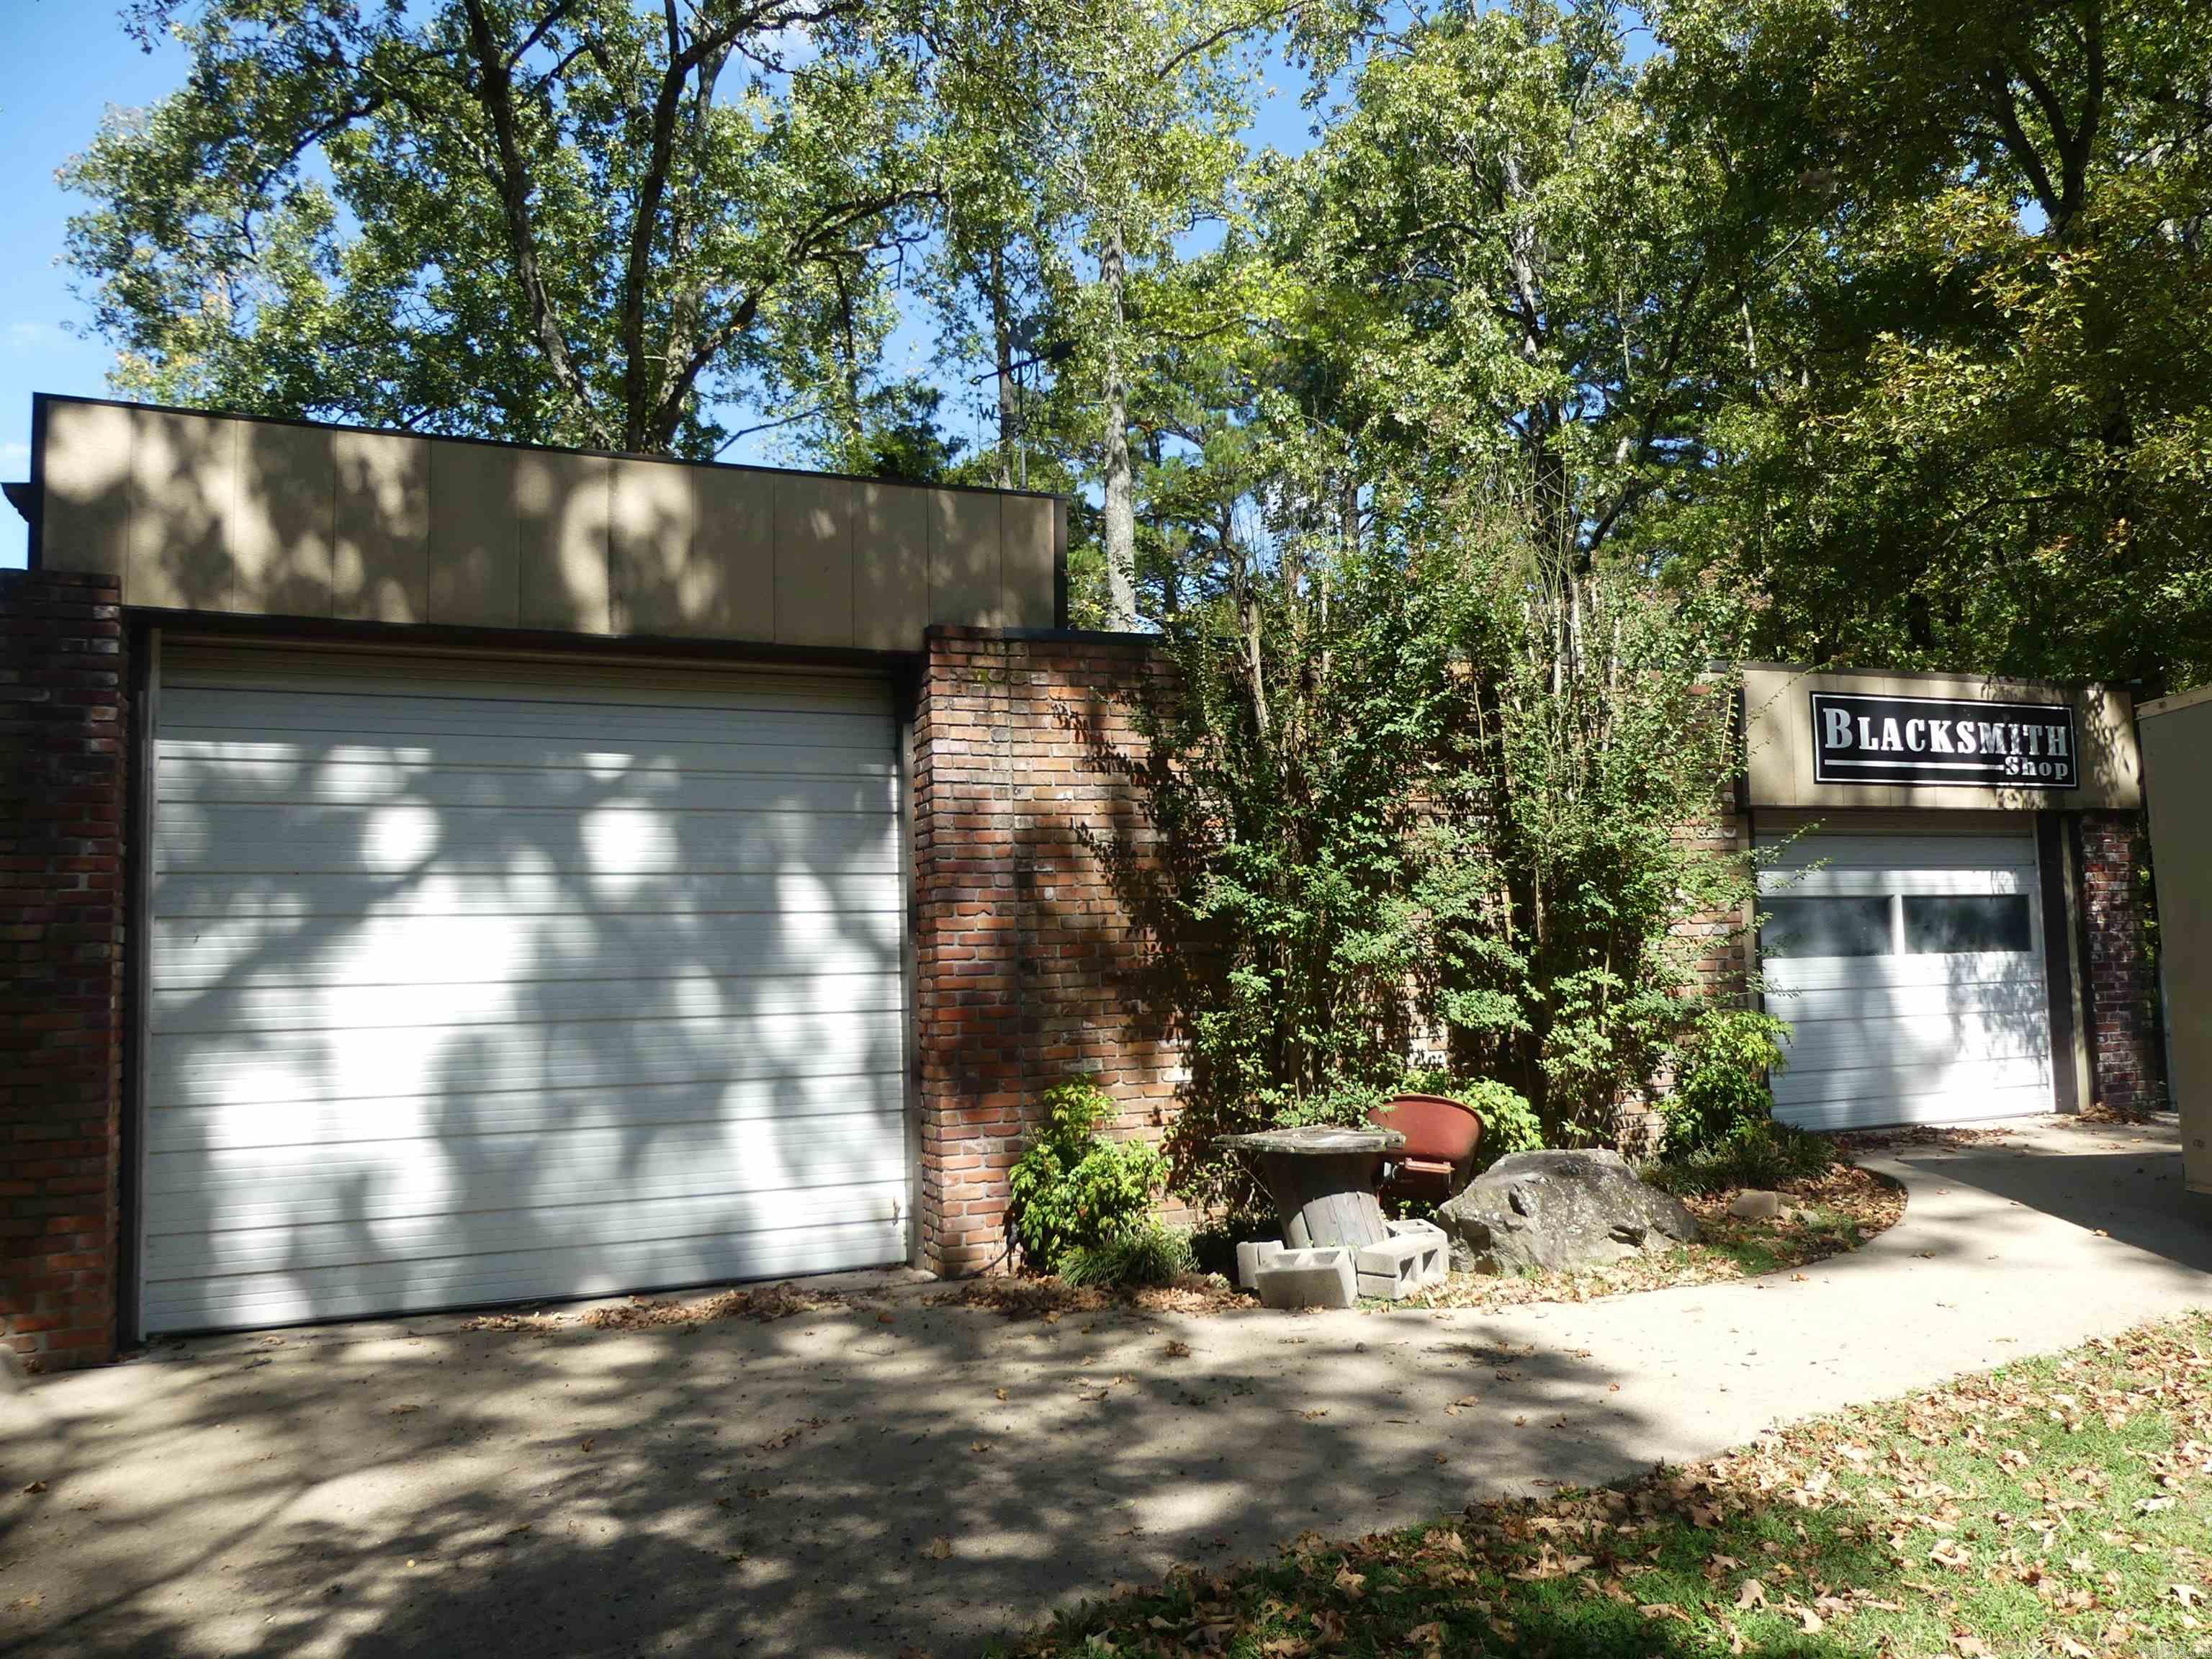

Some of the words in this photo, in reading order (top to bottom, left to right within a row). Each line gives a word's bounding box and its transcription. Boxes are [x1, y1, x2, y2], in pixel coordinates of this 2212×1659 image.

[979, 403, 997, 421] W
[1822, 708, 2068, 756] BLACKSMITH
[2005, 756, 2068, 780] Shop
